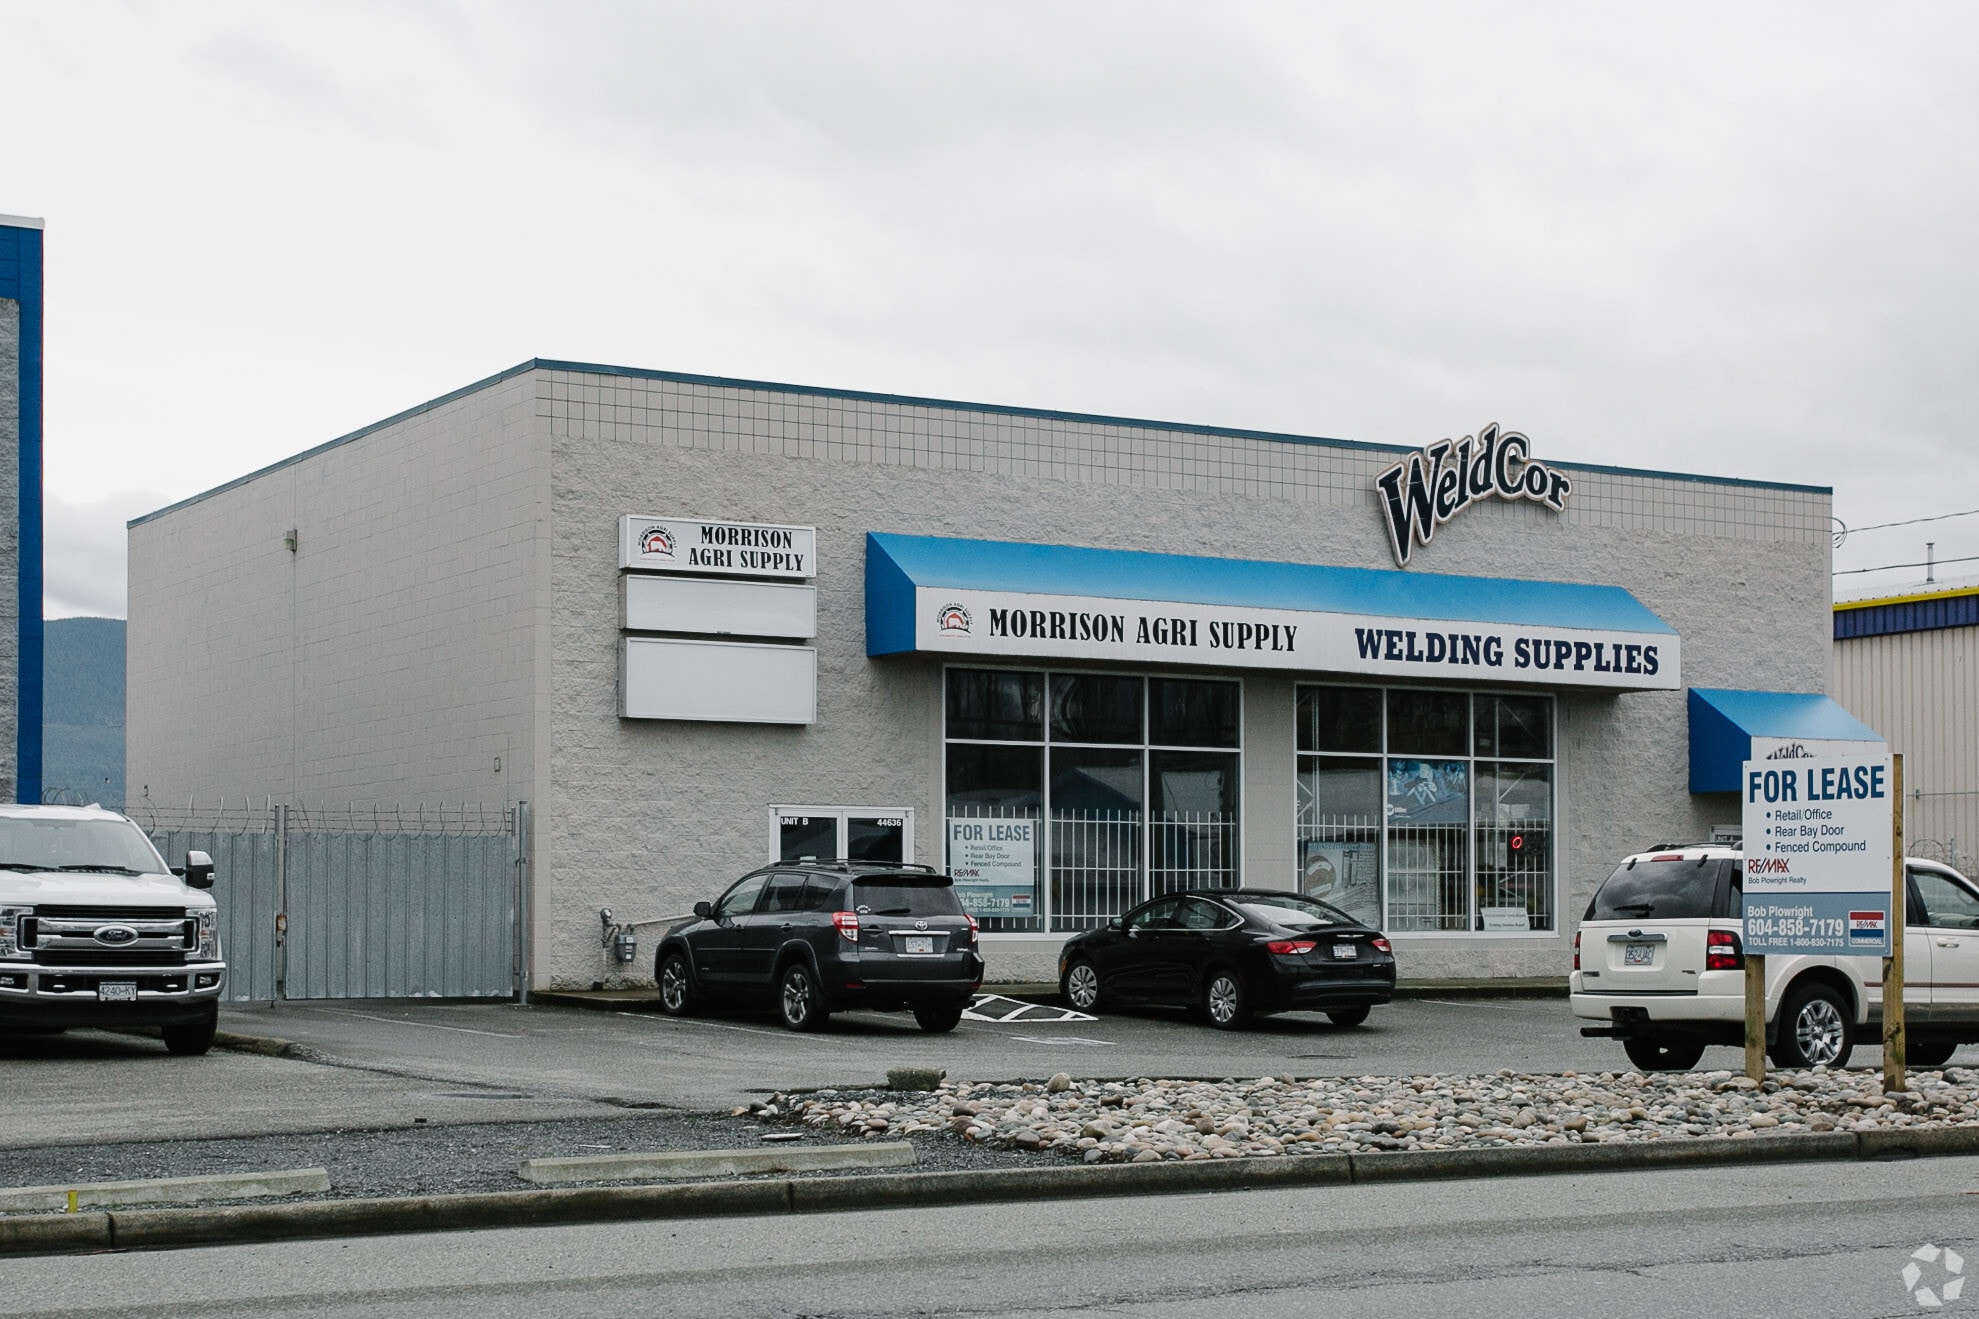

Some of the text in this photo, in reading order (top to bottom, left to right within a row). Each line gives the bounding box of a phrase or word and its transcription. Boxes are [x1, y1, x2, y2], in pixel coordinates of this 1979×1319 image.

[1376, 423, 1571, 567] WeldCor
[700, 525, 793, 549] MORRISON
[688, 547, 804, 572] AGRI SUPPLY
[989, 608, 1298, 652] MORRISON AGRI SUPPLY
[1354, 628, 1659, 676] WELDING SUPPLIES
[1749, 765, 1885, 803] FOR LEASE
[780, 817, 809, 825] UNIT B
[953, 824, 1031, 841] FOR LEASE
[1774, 824, 1845, 839] Rear Bay Door
[1774, 839, 1866, 854] Fenced Compound
[1748, 857, 1790, 874] RE/MAX
[1748, 876, 1807, 886] Bob Plowright Realty
[1747, 905, 1813, 920] Bob Plowright
[1748, 918, 1844, 936] 604-858-7179
[1748, 937, 1768, 946] TOLL
[1768, 937, 1788, 946] FREE
